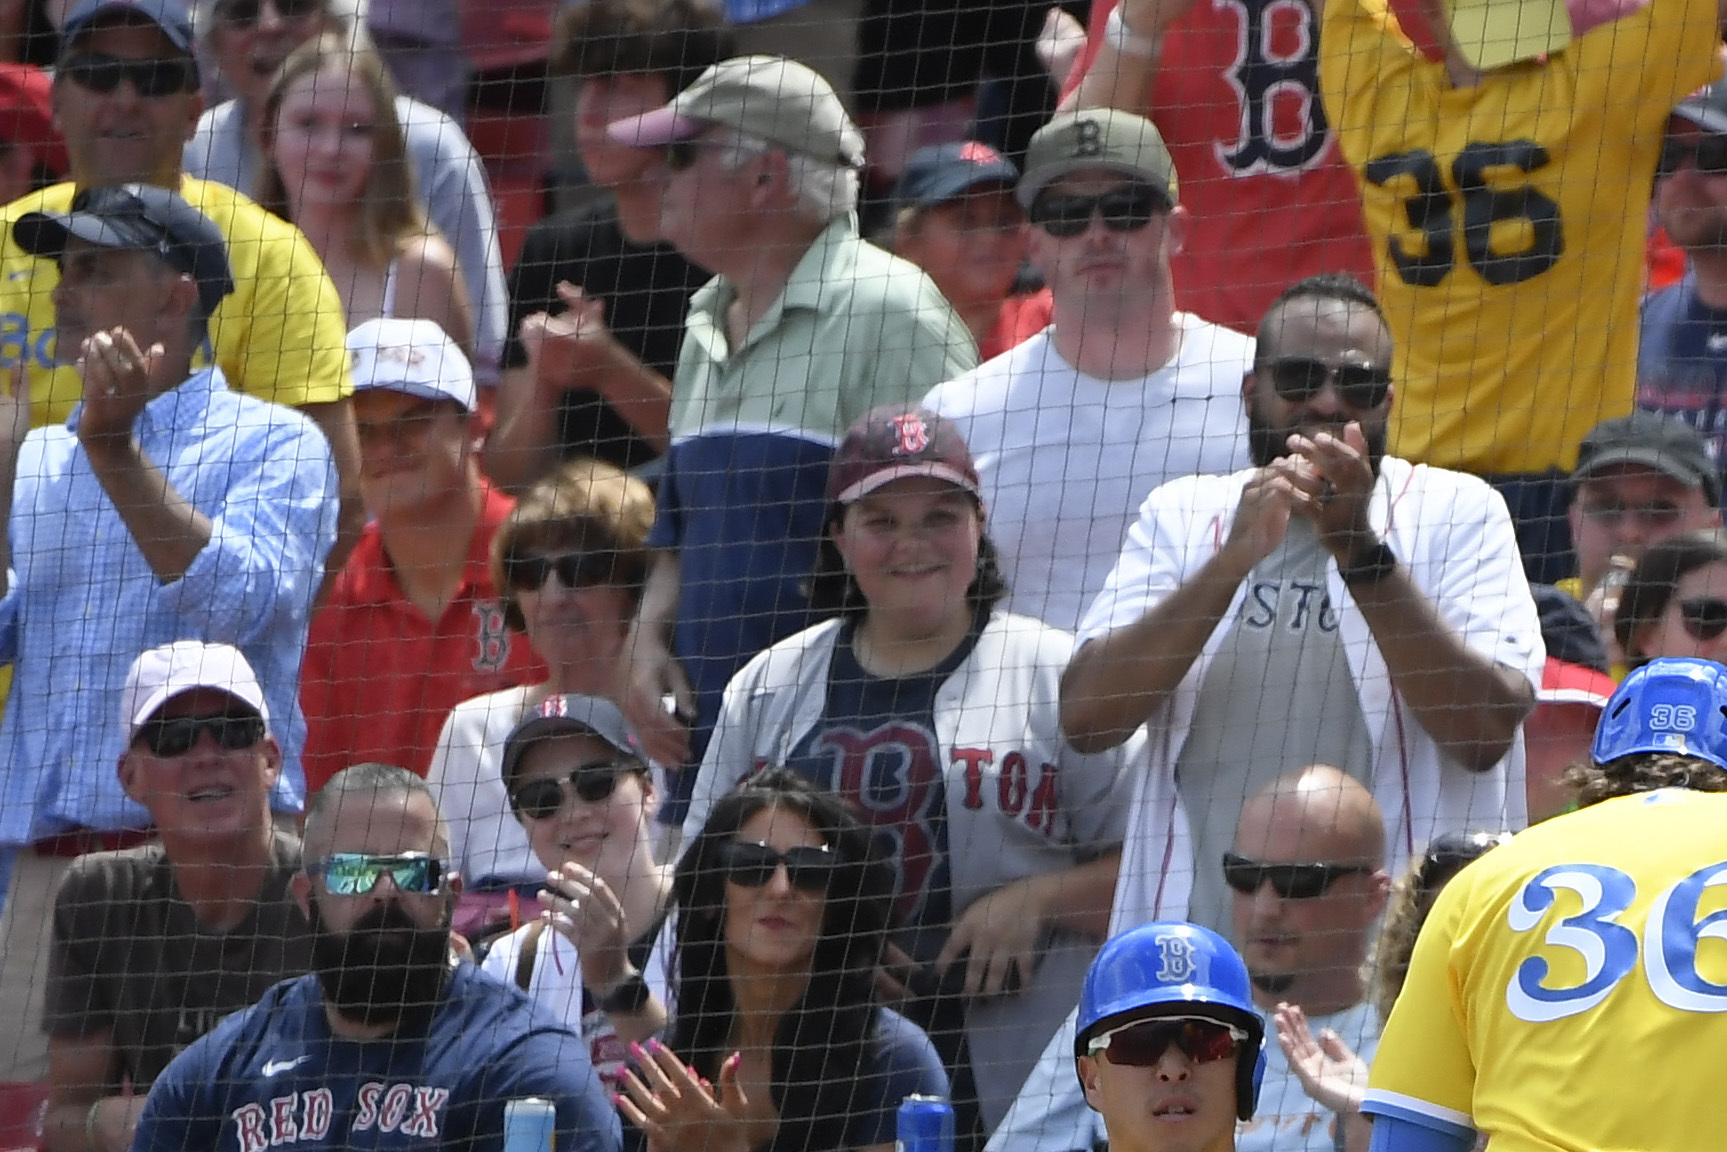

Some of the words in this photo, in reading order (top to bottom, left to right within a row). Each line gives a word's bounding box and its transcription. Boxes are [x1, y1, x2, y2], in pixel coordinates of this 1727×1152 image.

[1214, 0, 1335, 178] B
[1367, 139, 1564, 286] 36
[1245, 581, 1339, 632] STO
[471, 601, 511, 673] B
[1649, 703, 1697, 731] 36
[1155, 934, 1196, 982] B
[352, 1082, 449, 1137] SOX
